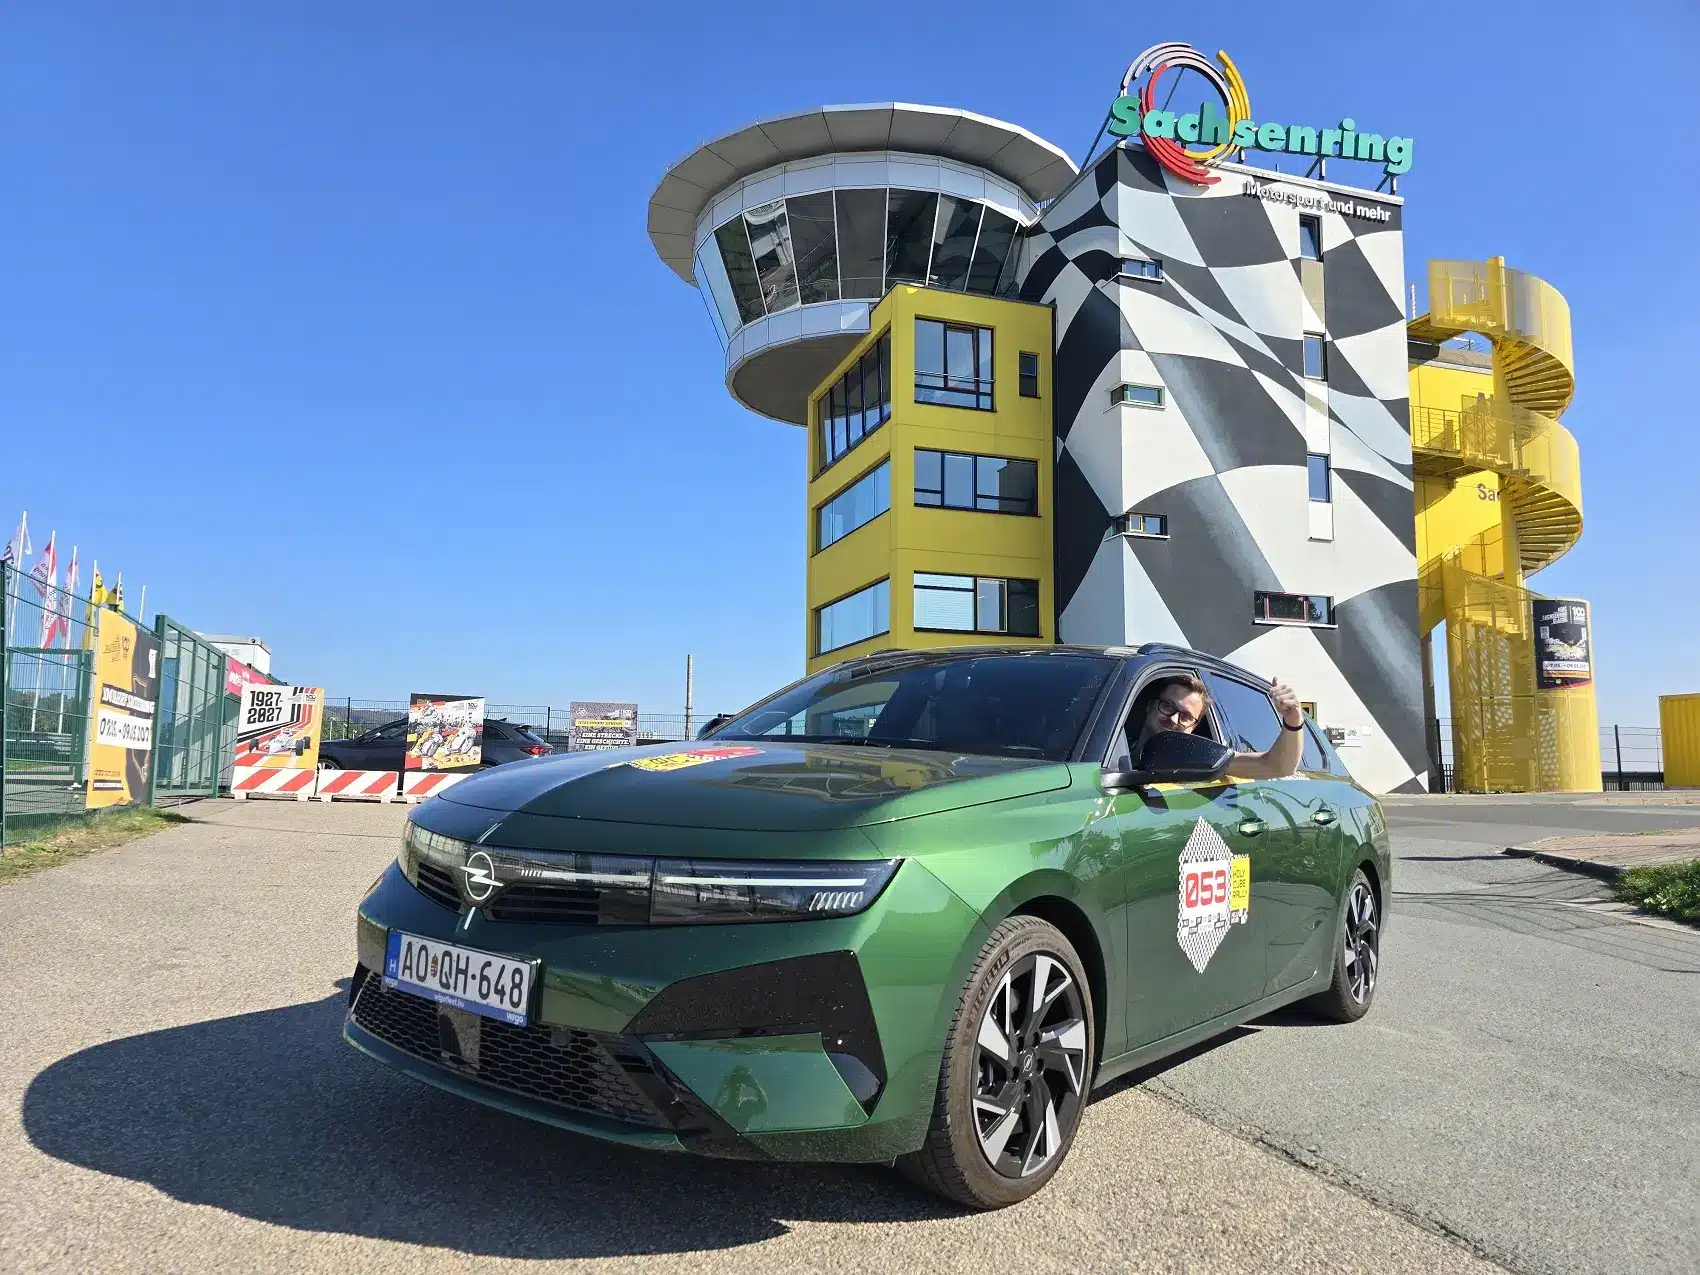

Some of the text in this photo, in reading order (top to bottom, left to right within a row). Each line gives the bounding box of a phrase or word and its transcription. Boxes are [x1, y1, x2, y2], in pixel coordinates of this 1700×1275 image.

[1107, 96, 1413, 176] Sachsenring
[1245, 180, 1391, 222] Motorsport und mehr
[247, 706, 282, 724] 2027
[1185, 869, 1227, 909] 053
[389, 958, 397, 973] H
[401, 940, 429, 983] AO
[506, 1011, 524, 1025] wigo
